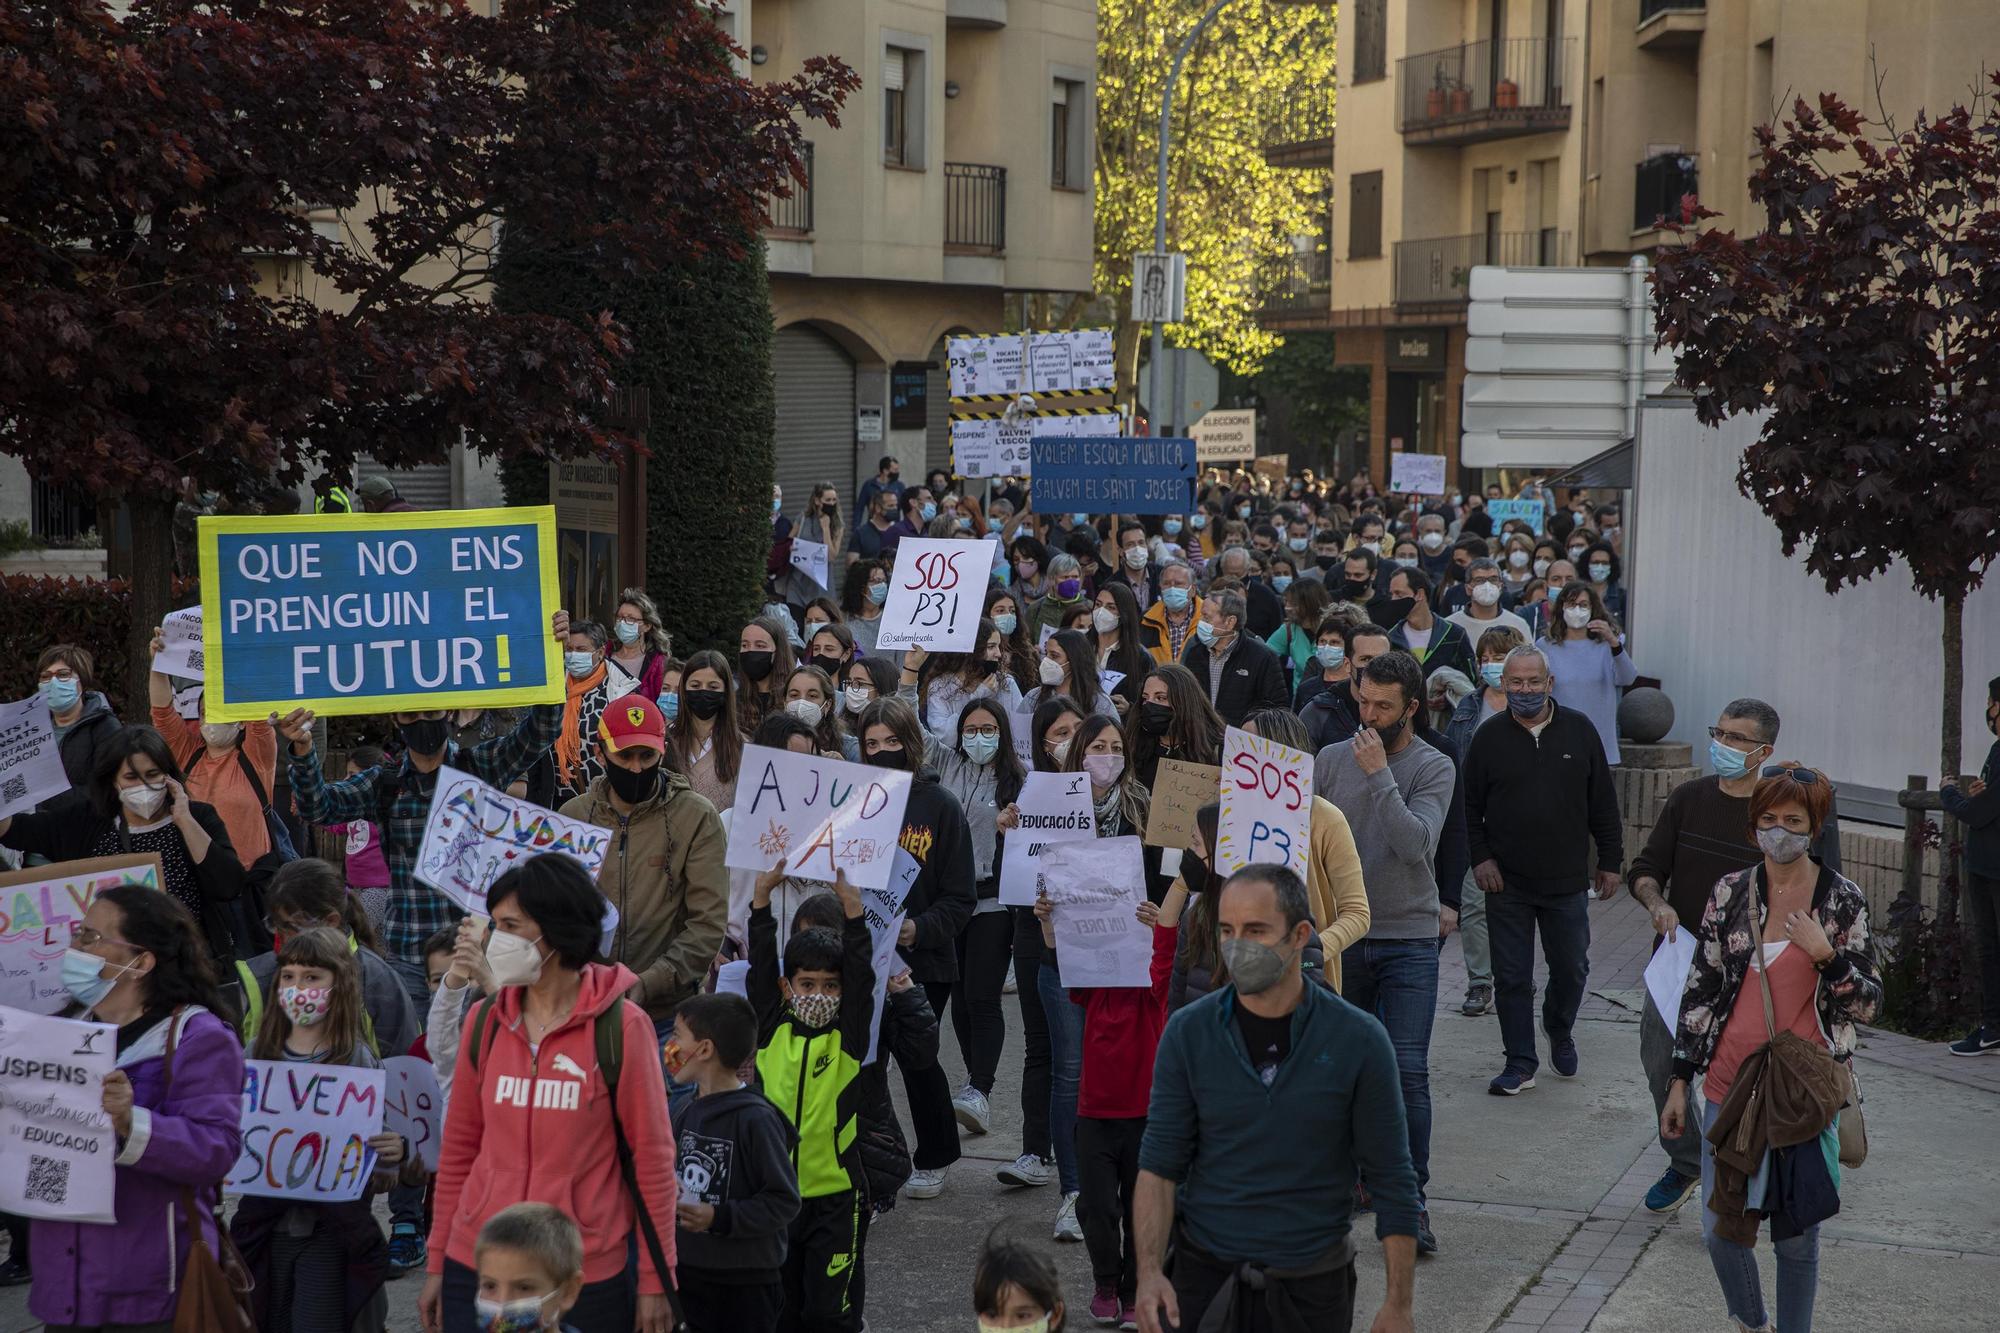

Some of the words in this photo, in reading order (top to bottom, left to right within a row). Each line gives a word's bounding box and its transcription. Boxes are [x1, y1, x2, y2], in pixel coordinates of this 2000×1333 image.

[950, 357, 966, 368] P3
[953, 431, 985, 439] SUSPENS
[1033, 443, 1078, 465] VOLEM
[1083, 443, 1128, 465] ESCOLA
[1035, 478, 1080, 500] SALVEM
[1085, 478, 1098, 500] EL
[1102, 478, 1137, 500] SANT
[1144, 478, 1185, 500] JOSEP
[238, 543, 322, 583] QUE
[358, 540, 418, 577] NO
[450, 534, 524, 572] ENS
[904, 551, 966, 590] SOS
[180, 612, 204, 625] INCO
[229, 590, 430, 634] PRENGUIN
[464, 586, 509, 621] EL
[909, 592, 959, 634] P3!
[293, 634, 511, 695] FUTUR!
[0, 747, 41, 773] UCACIÓ
[1233, 751, 1301, 811] SOS
[1019, 810, 1076, 830] 'EDUCACIÓ
[1077, 810, 1091, 830] ÉS
[1249, 821, 1291, 866] P3
[494, 1075, 581, 1110] PUMA
[23, 1126, 100, 1153] EDUCACIÓ
[228, 1123, 377, 1196] SCOLA!
